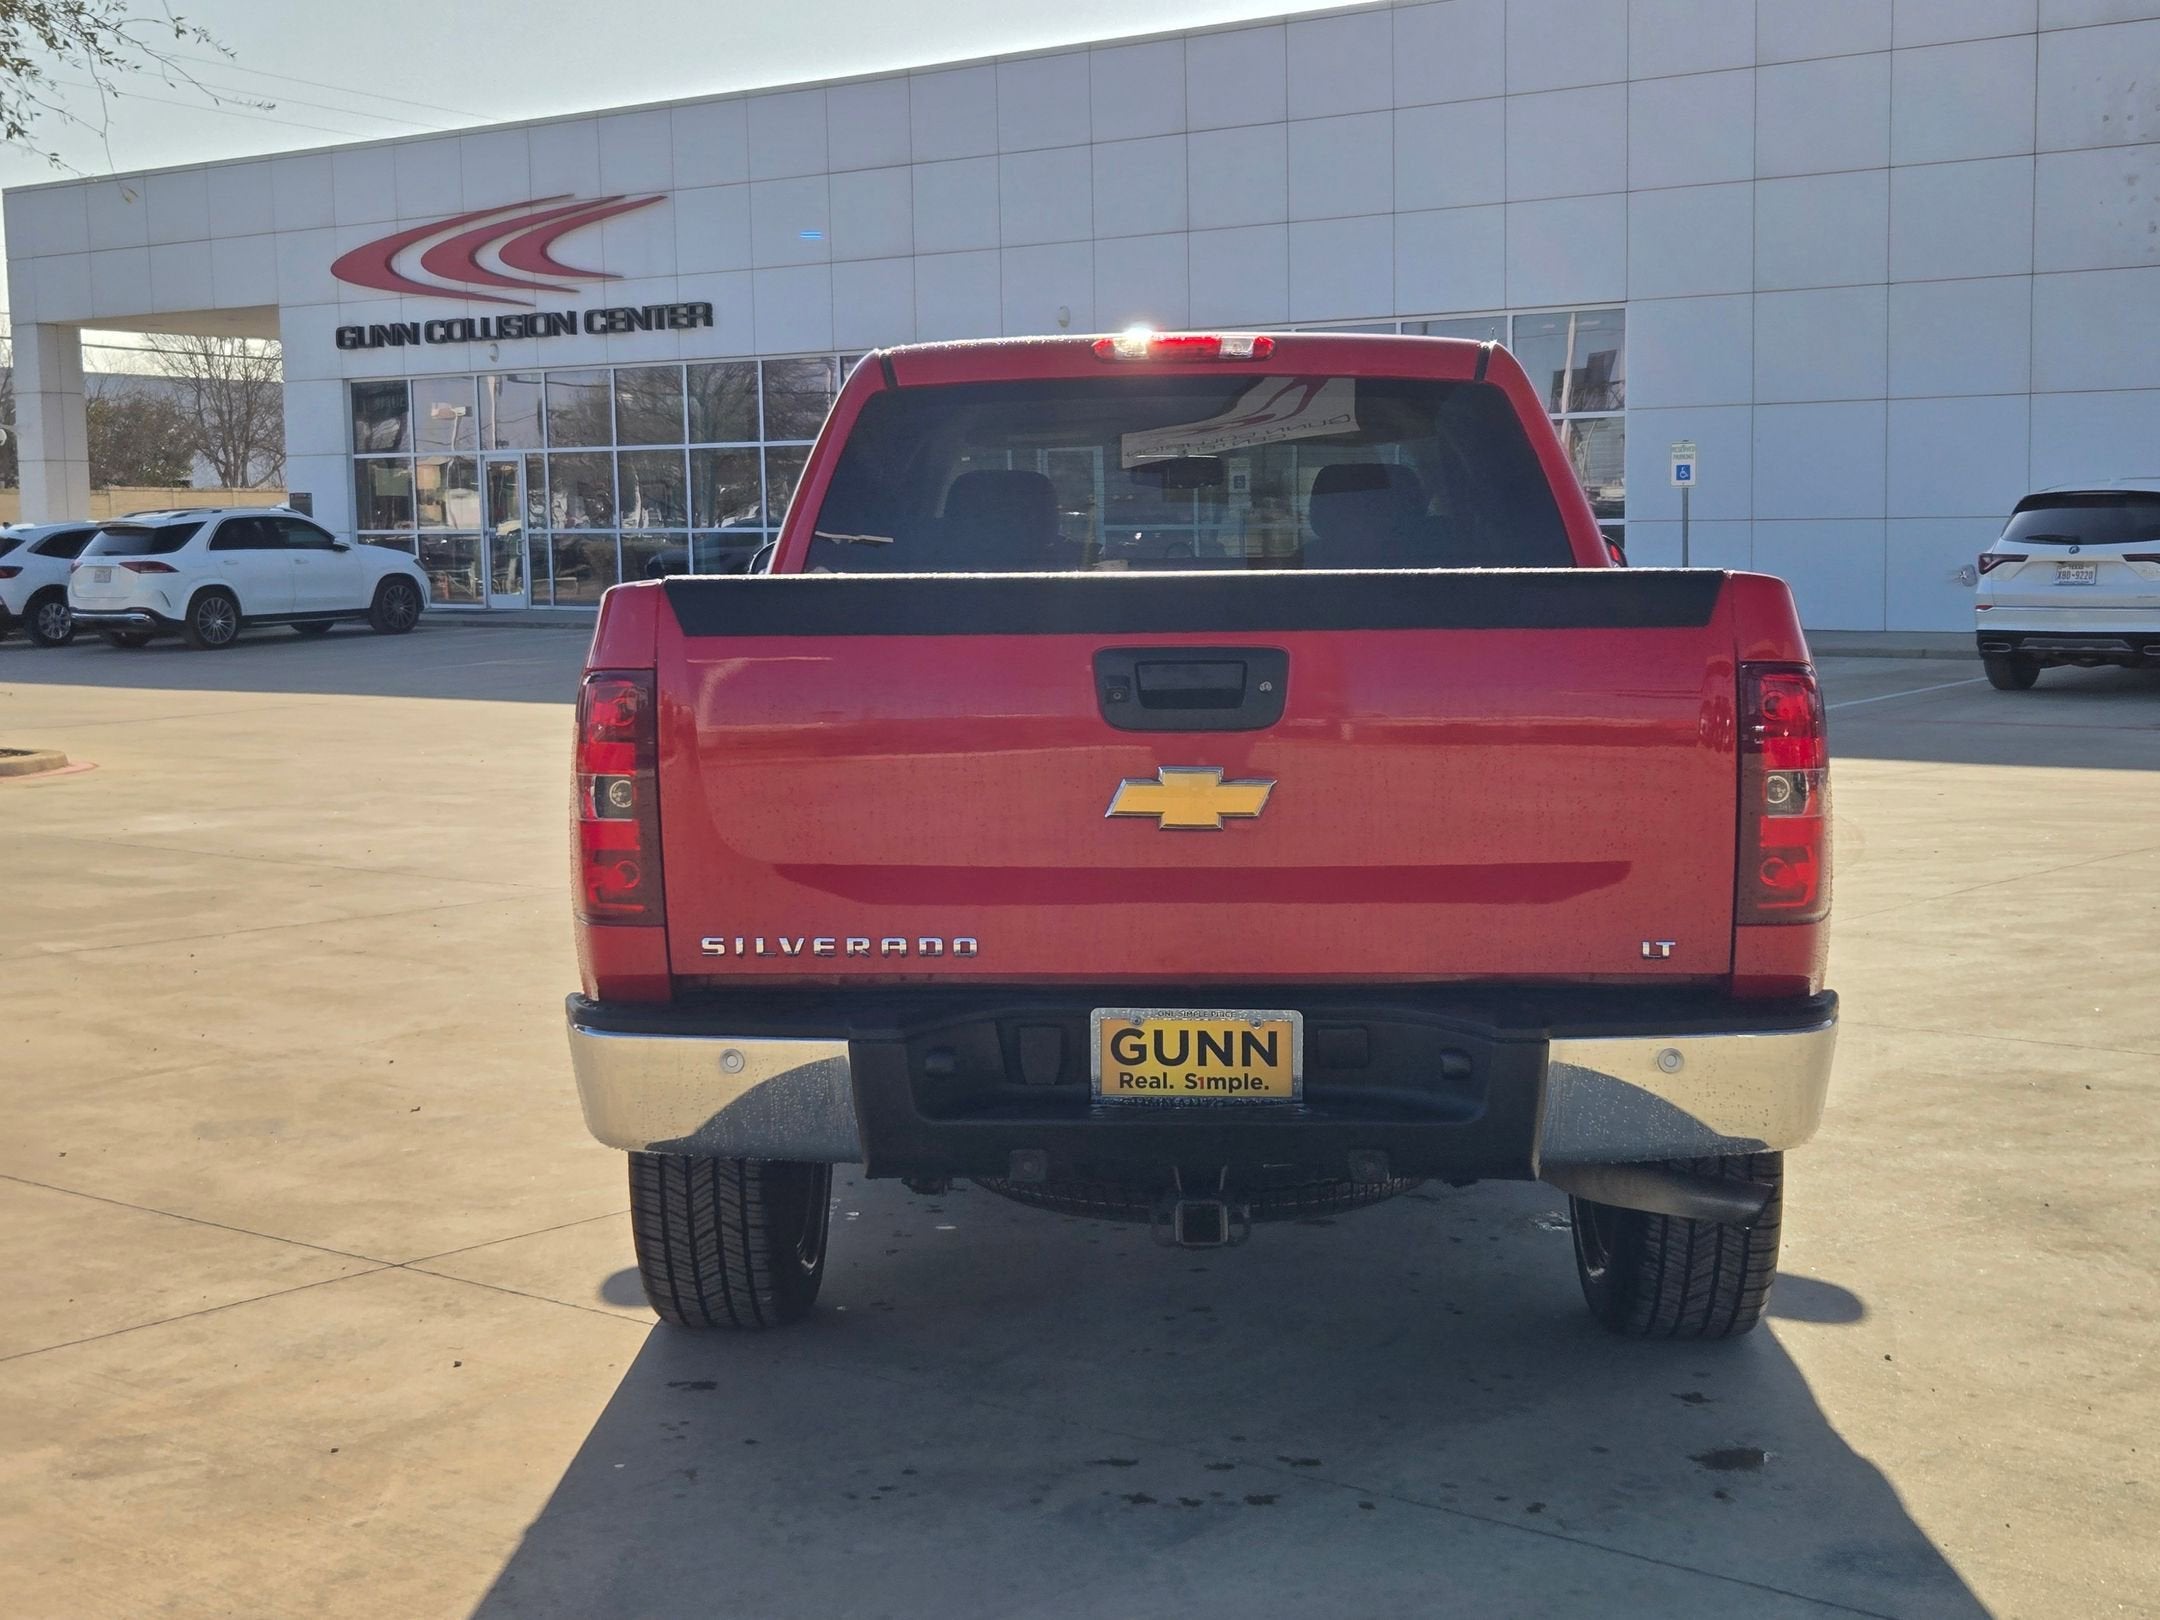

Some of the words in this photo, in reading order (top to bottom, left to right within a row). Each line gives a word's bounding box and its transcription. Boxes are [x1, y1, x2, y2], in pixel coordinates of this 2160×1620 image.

[336, 321, 421, 350] GUNN
[424, 310, 578, 344] COLLISION
[584, 301, 714, 334] CENTER
[701, 937, 979, 957] SILVERADO
[1642, 941, 1676, 959] LT
[1110, 1027, 1278, 1067] GUNN
[1119, 1072, 1174, 1089] Real.
